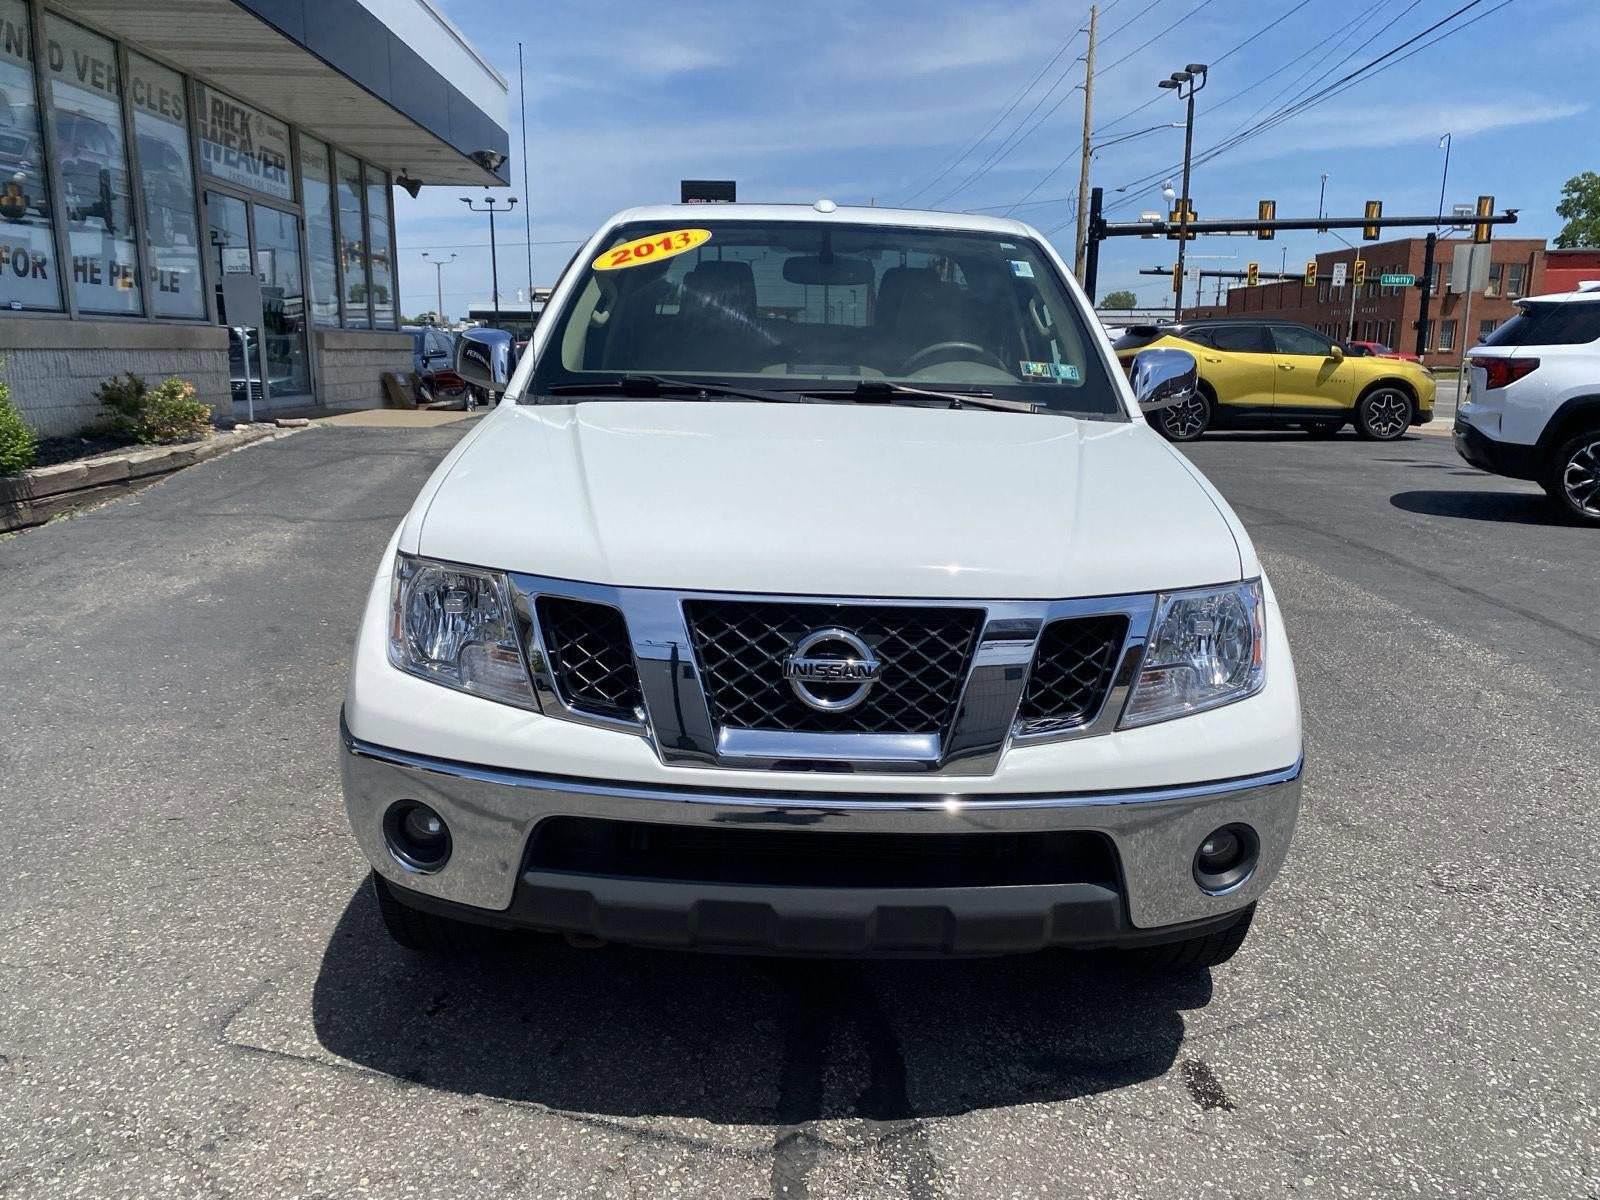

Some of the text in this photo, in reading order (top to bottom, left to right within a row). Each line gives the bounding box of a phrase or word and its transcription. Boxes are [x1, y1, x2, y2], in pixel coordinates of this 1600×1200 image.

[72, 49, 183, 121] VEHCLES
[211, 96, 253, 142] RICK
[0, 246, 48, 279] FOR
[73, 256, 102, 285] HE
[610, 232, 690, 266] 2013
[1384, 275, 1411, 286] Liberty
[789, 661, 873, 678] NISSAN
